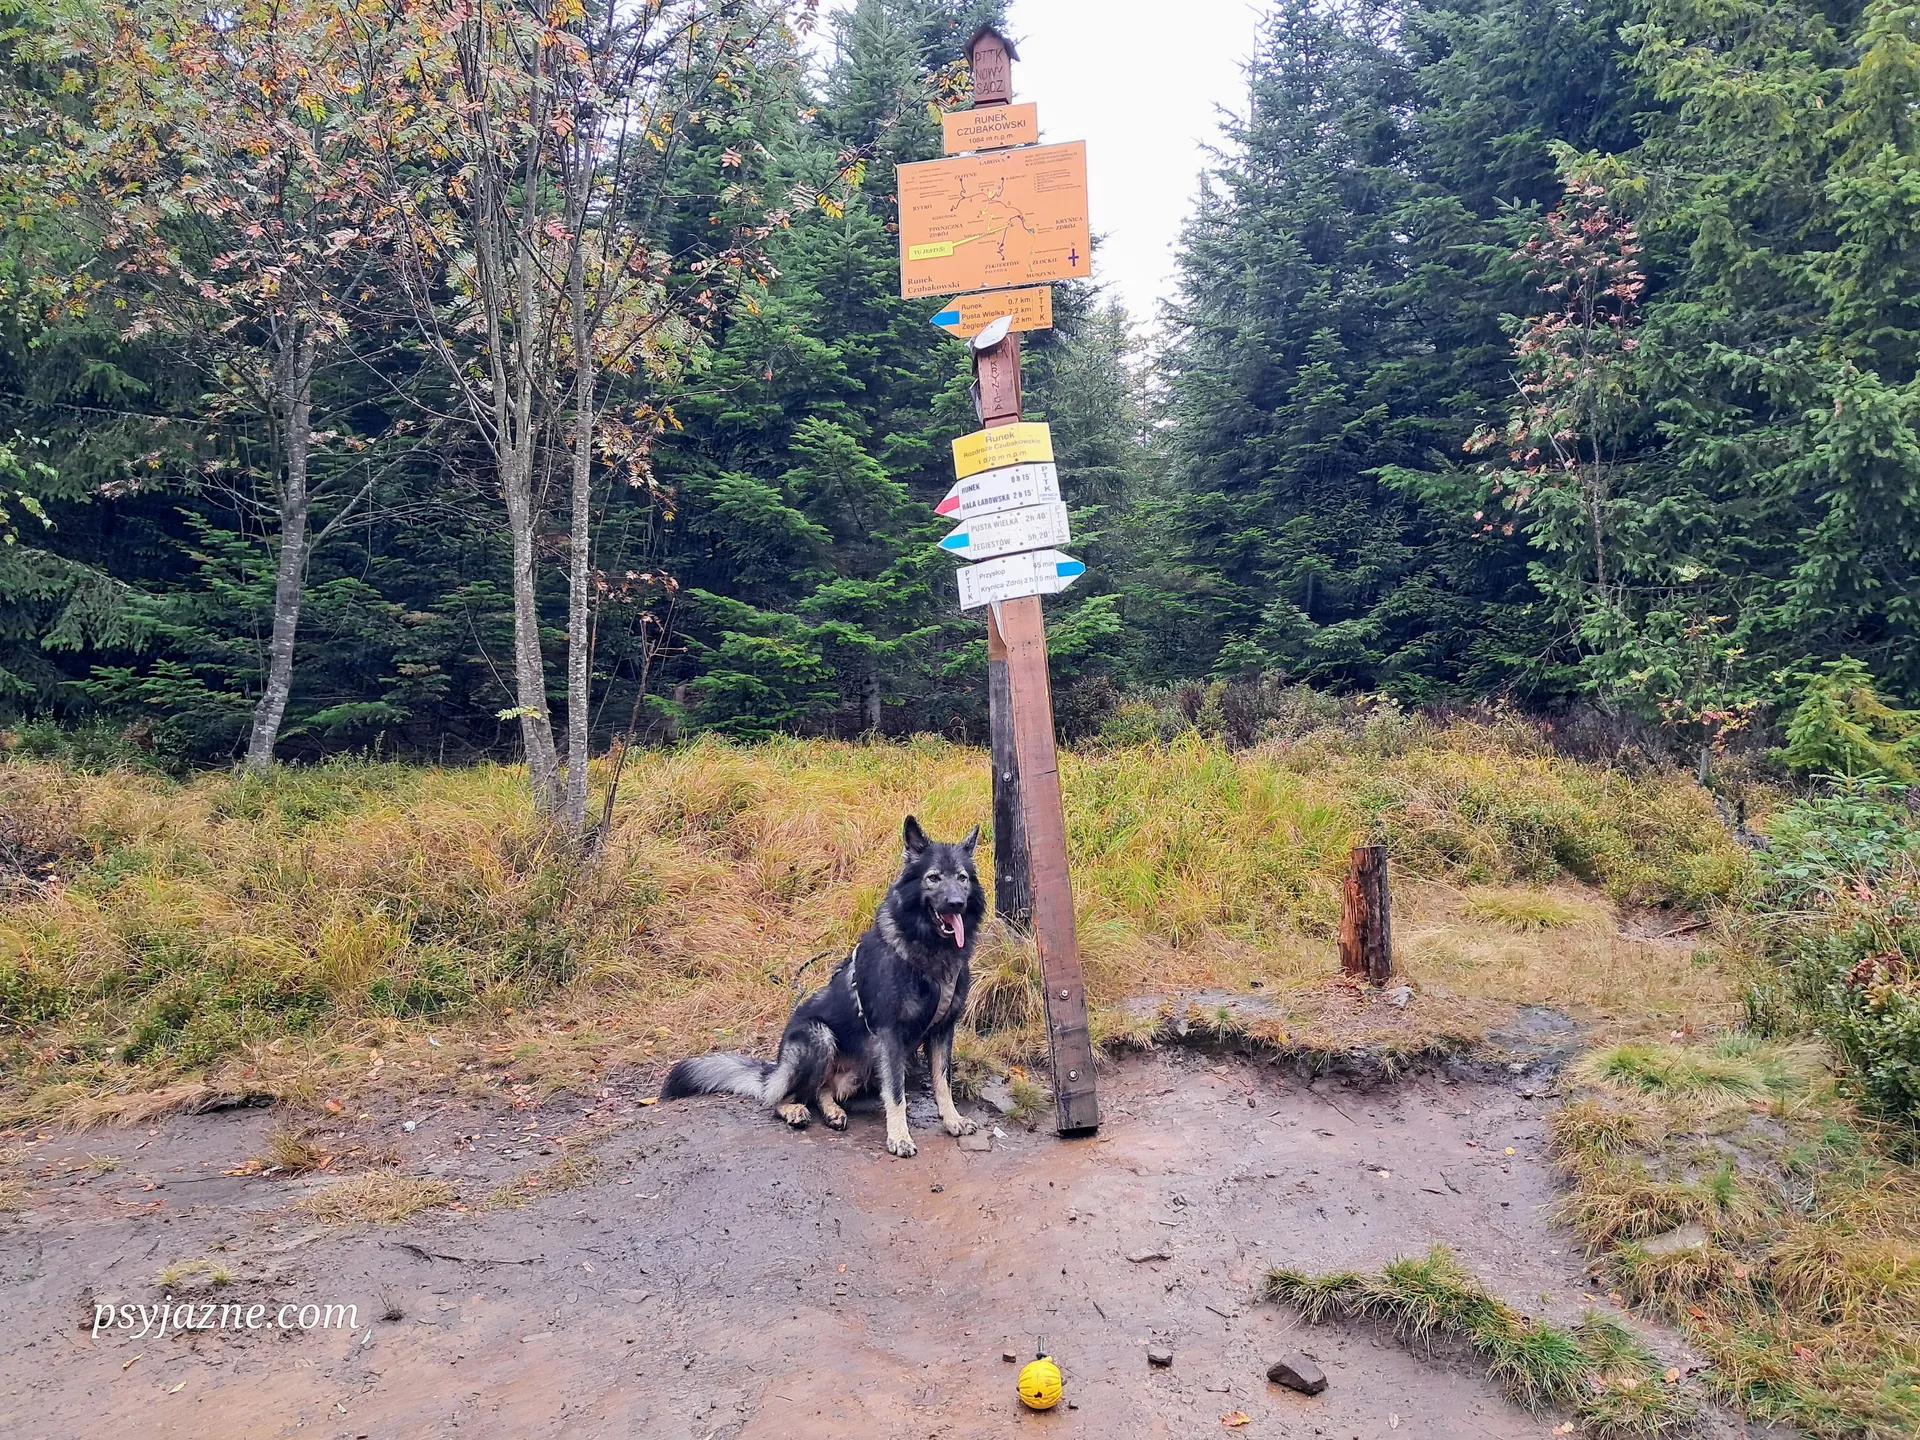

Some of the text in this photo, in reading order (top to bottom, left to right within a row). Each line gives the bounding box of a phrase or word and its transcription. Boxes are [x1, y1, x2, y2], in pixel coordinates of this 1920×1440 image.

[975, 66, 1003, 81] NOWY
[974, 113, 1008, 125] RUNEK
[956, 120, 1027, 137] CZUBAKOWSKI
[968, 136, 985, 145] 1084
[908, 276, 933, 285] Runek
[907, 281, 960, 294] Czubakowski
[961, 303, 983, 311] Runek
[961, 312, 981, 320] Pusta
[982, 310, 1005, 318] Wielka
[985, 431, 1015, 443] Runek
[963, 439, 1041, 458] Rozdroże Czubakowskie
[961, 483, 981, 494] RUNEK
[962, 501, 977, 511] HALA
[970, 522, 993, 533] PUSTA
[994, 517, 1019, 529] WIELKA
[979, 568, 1006, 579] Przysłop
[980, 578, 1024, 593] Krynica-Zdrój
